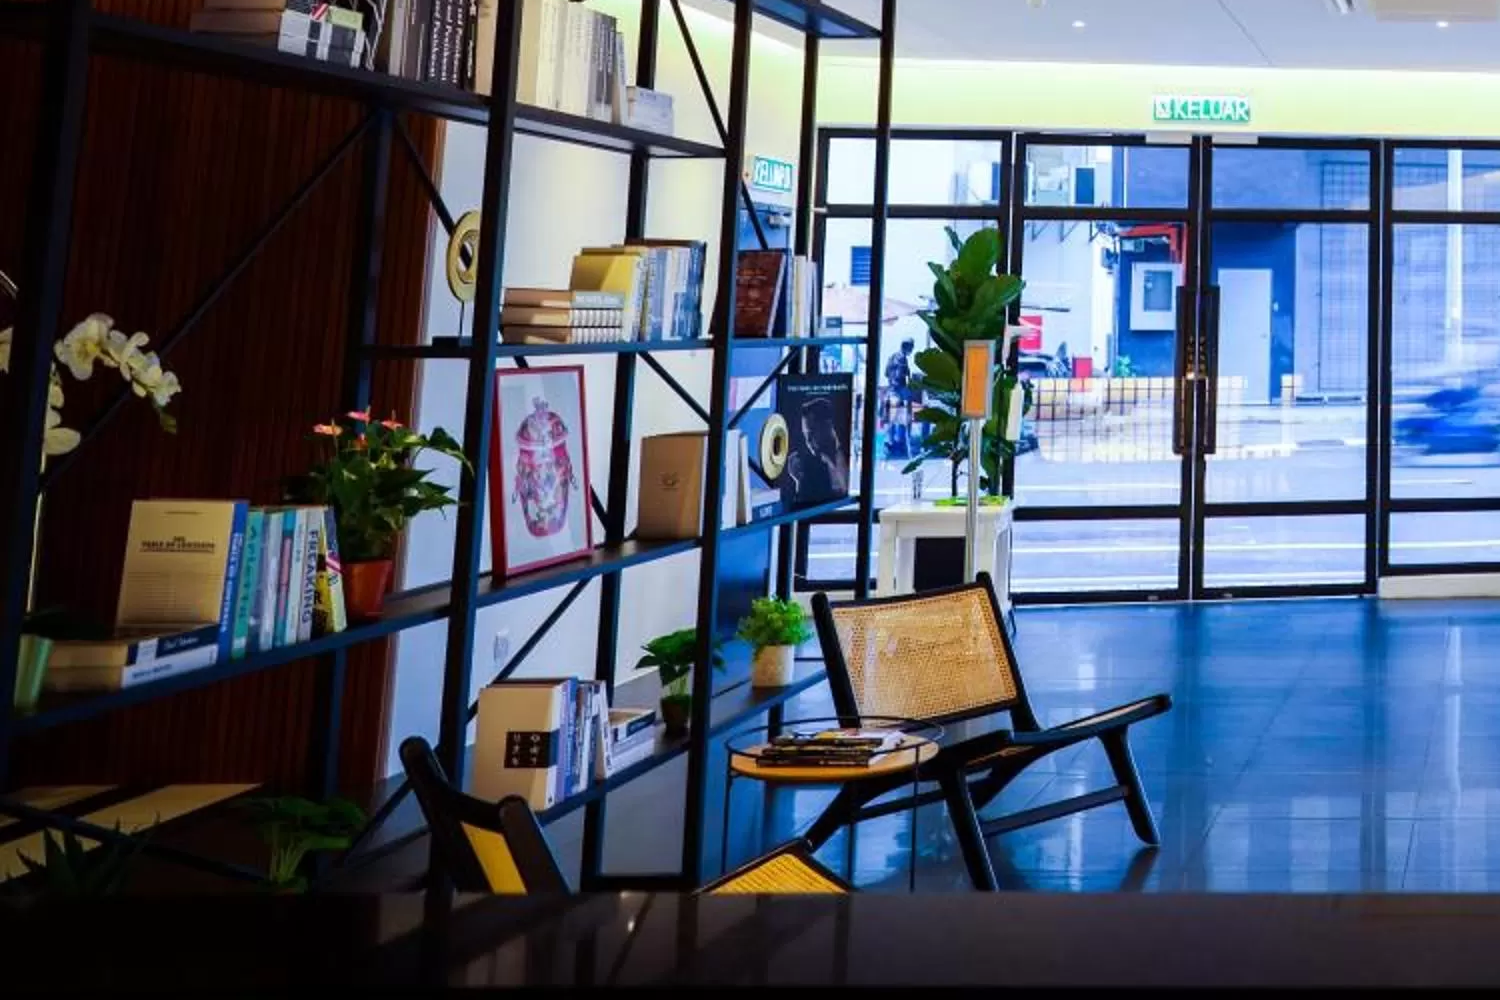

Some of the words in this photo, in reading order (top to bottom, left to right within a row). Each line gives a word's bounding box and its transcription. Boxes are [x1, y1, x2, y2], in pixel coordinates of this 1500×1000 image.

[429, 21, 441, 77] Punishment
[441, 25, 453, 81] Punishment
[452, 27, 464, 84] Punishment
[1174, 98, 1249, 120] KELUAR
[301, 530, 319, 624] FREAKING
